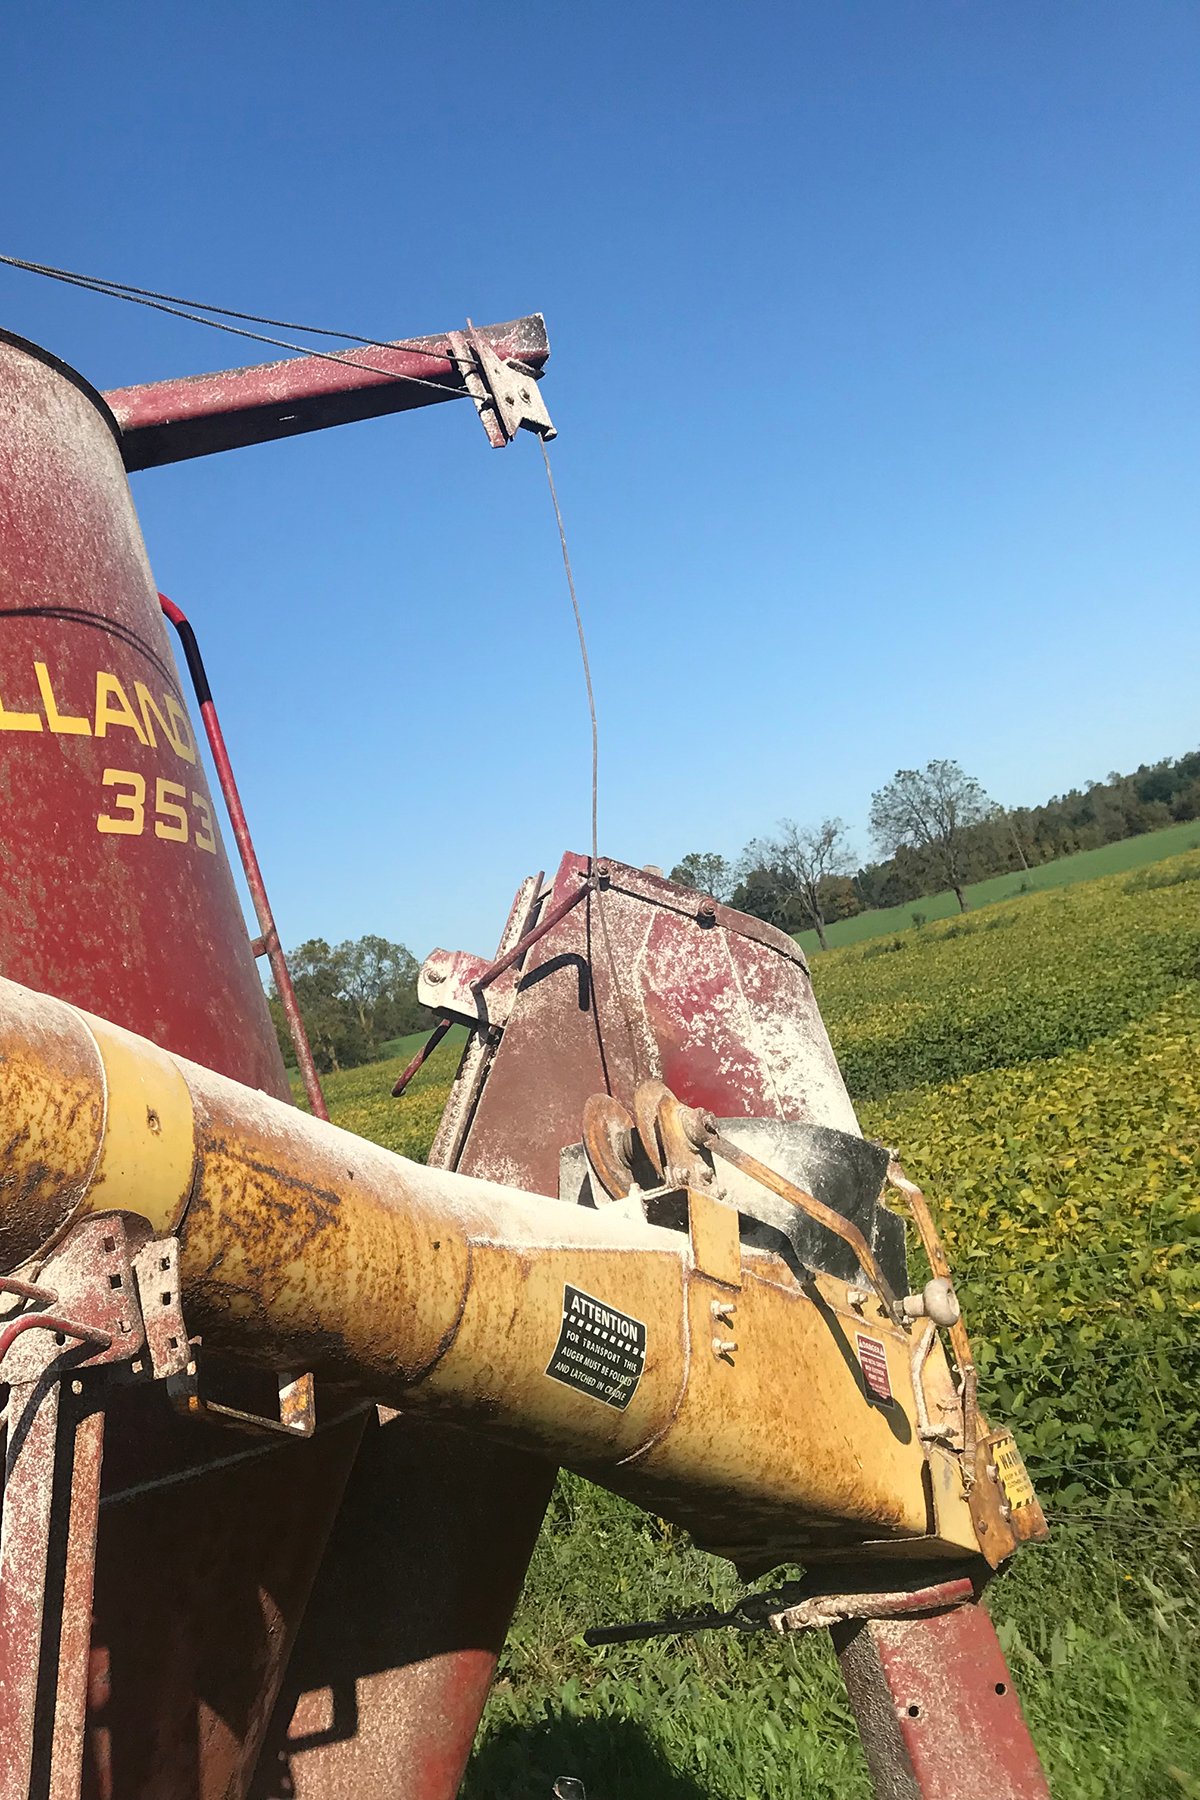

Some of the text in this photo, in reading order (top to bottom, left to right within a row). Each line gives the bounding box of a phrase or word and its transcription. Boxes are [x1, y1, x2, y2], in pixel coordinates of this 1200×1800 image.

[97, 768, 217, 855] 353
[571, 1295, 638, 1342] ATTENTION
[561, 1346, 633, 1387] AUGER MUST BE FOLDED
[566, 1330, 638, 1373] FOR TRANSPORT THIS
[555, 1361, 627, 1401] AND LATCHED IN CRADLE
